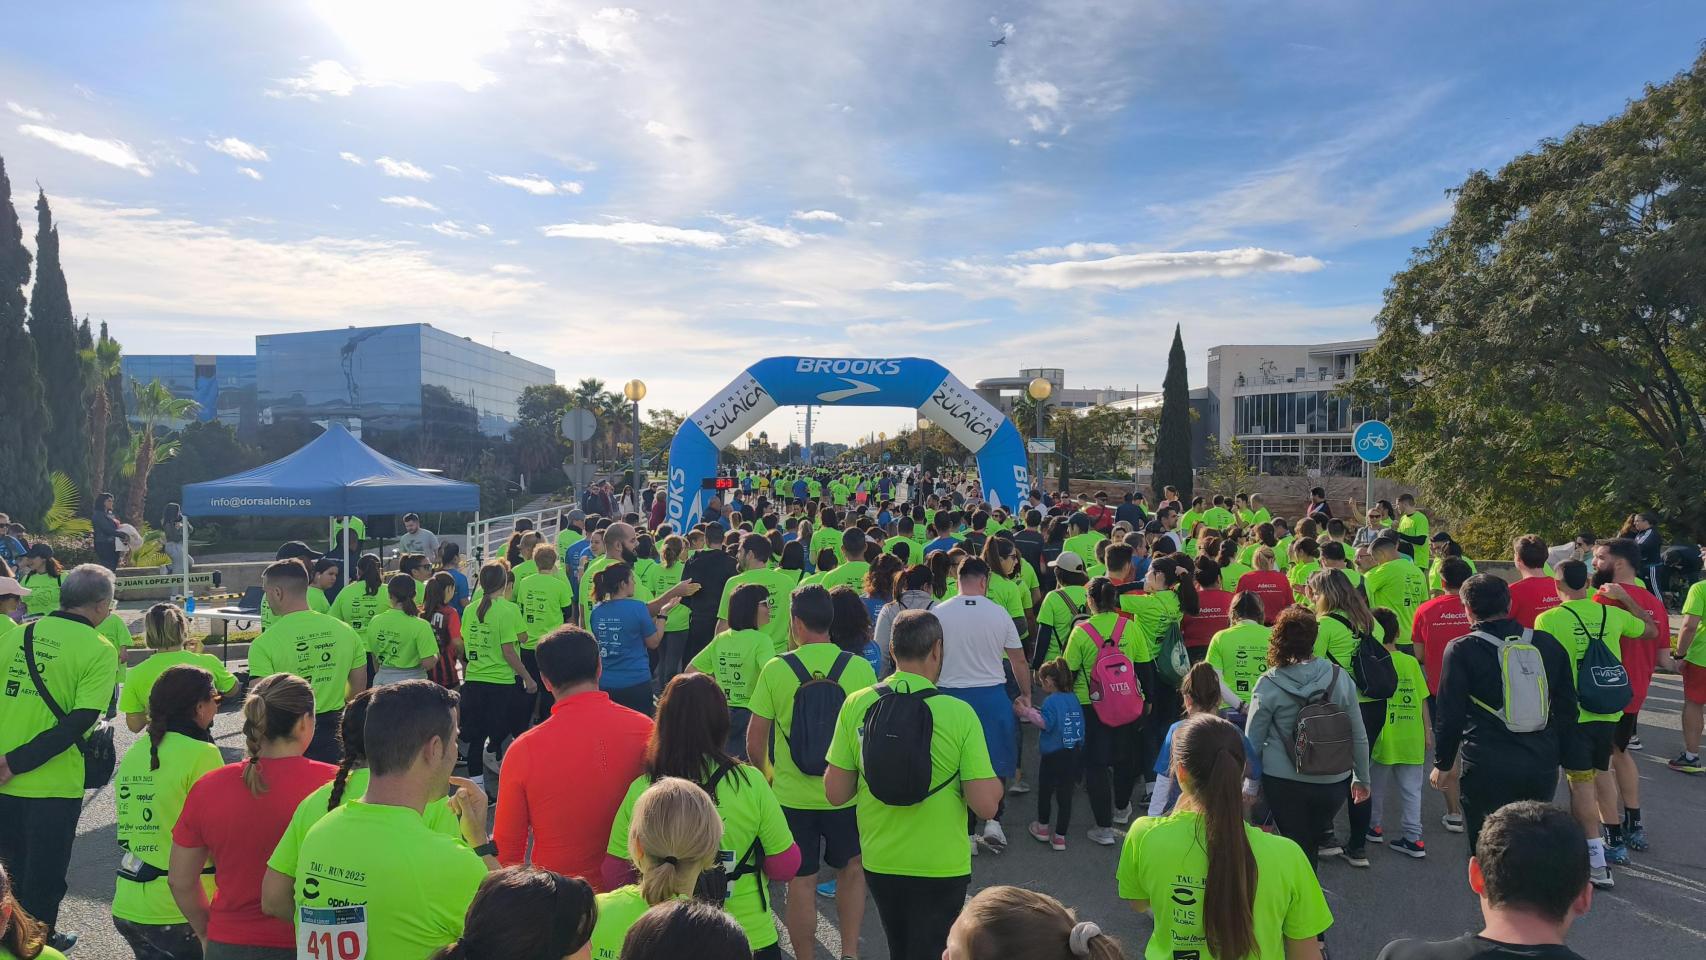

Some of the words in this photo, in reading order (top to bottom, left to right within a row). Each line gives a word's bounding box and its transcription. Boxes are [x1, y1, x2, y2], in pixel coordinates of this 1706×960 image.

[796, 358, 902, 375] BROOKS
[697, 378, 757, 426] DEPORTES
[942, 381, 999, 428] DEPORTES
[210, 496, 312, 508] info@dorsalchip.es
[171, 575, 210, 584] PEALVER
[1110, 682, 1131, 692] VITA
[134, 844, 159, 853] AERTEC
[311, 861, 323, 873] TAU
[329, 866, 343, 878] RUN
[345, 870, 366, 882] 2025
[1176, 874, 1193, 884] TAU
[307, 930, 361, 960] 410
